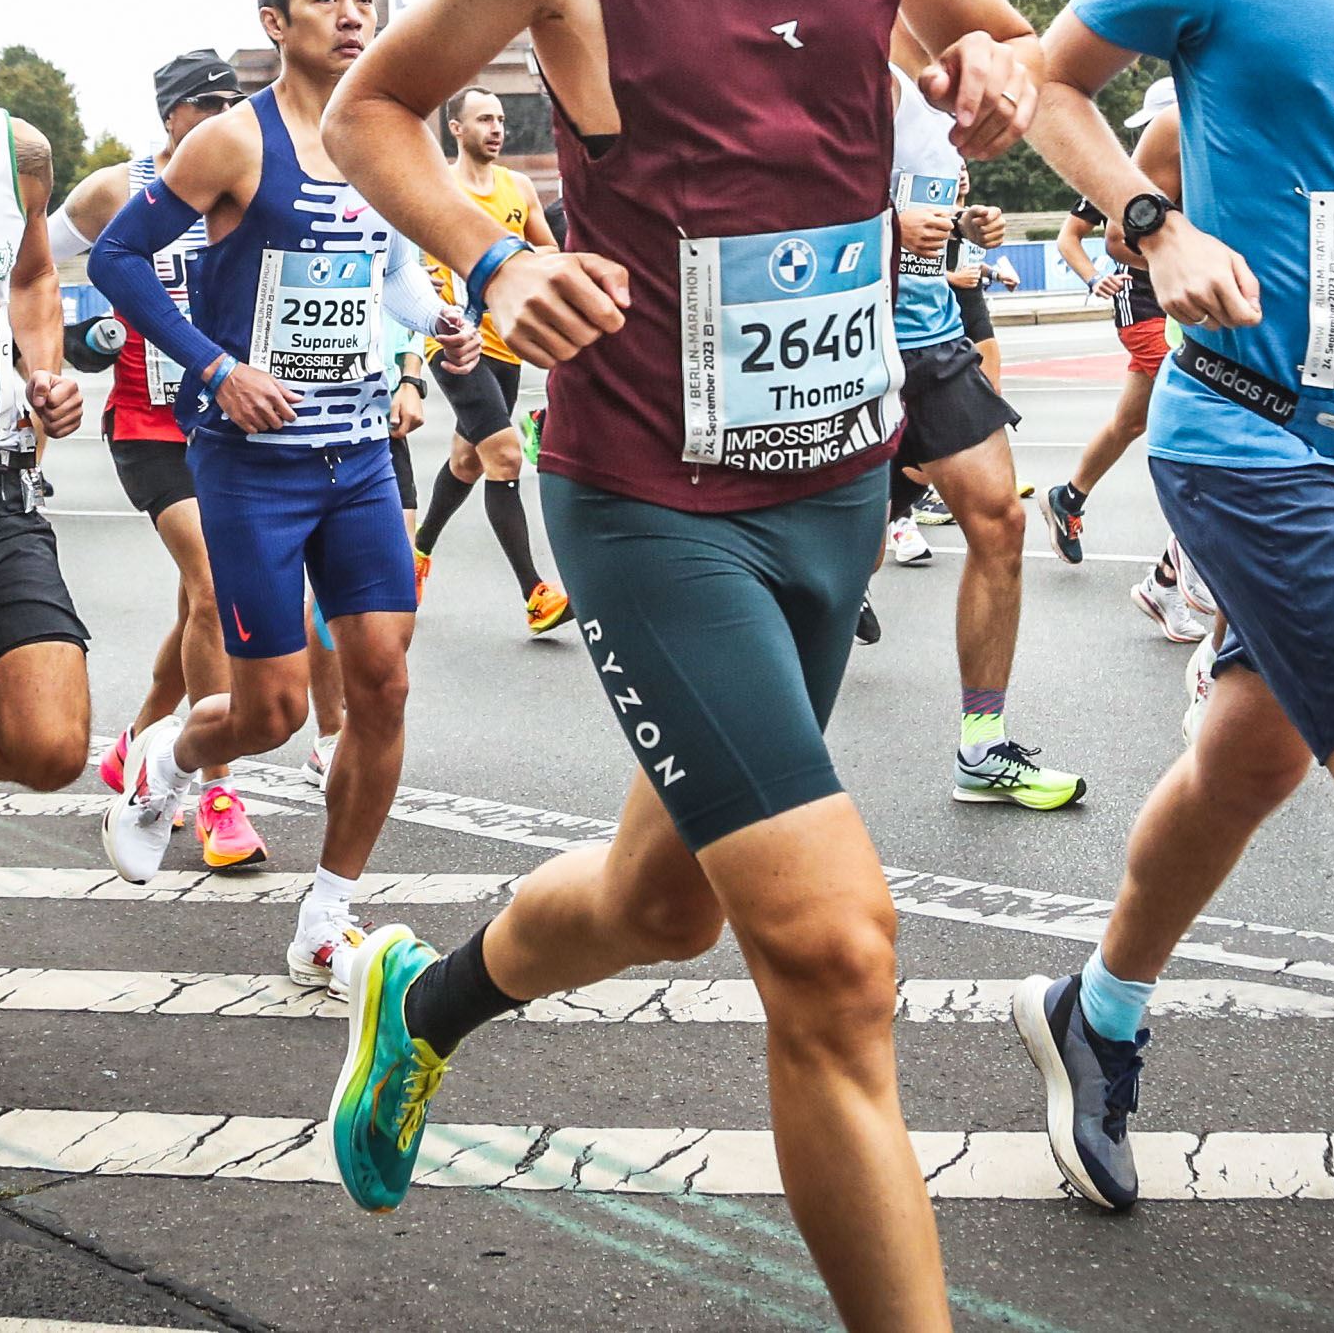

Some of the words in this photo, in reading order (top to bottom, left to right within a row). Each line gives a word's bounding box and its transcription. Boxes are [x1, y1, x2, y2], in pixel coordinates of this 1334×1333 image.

[281, 298, 366, 326] 29285
[291, 333, 358, 351] Suparuek
[741, 303, 876, 373] 26461
[273, 352, 344, 367] IMPOSSIBLE
[703, 341, 714, 370] 2023
[271, 367, 282, 378] IS
[285, 368, 340, 380] NOTHING
[1195, 355, 1264, 401] adidas
[704, 373, 717, 437] September
[769, 377, 865, 411] Thomas
[726, 415, 845, 451] IMPOSSIBLE
[750, 444, 840, 471] NOTHING
[583, 618, 686, 787] RYZON
